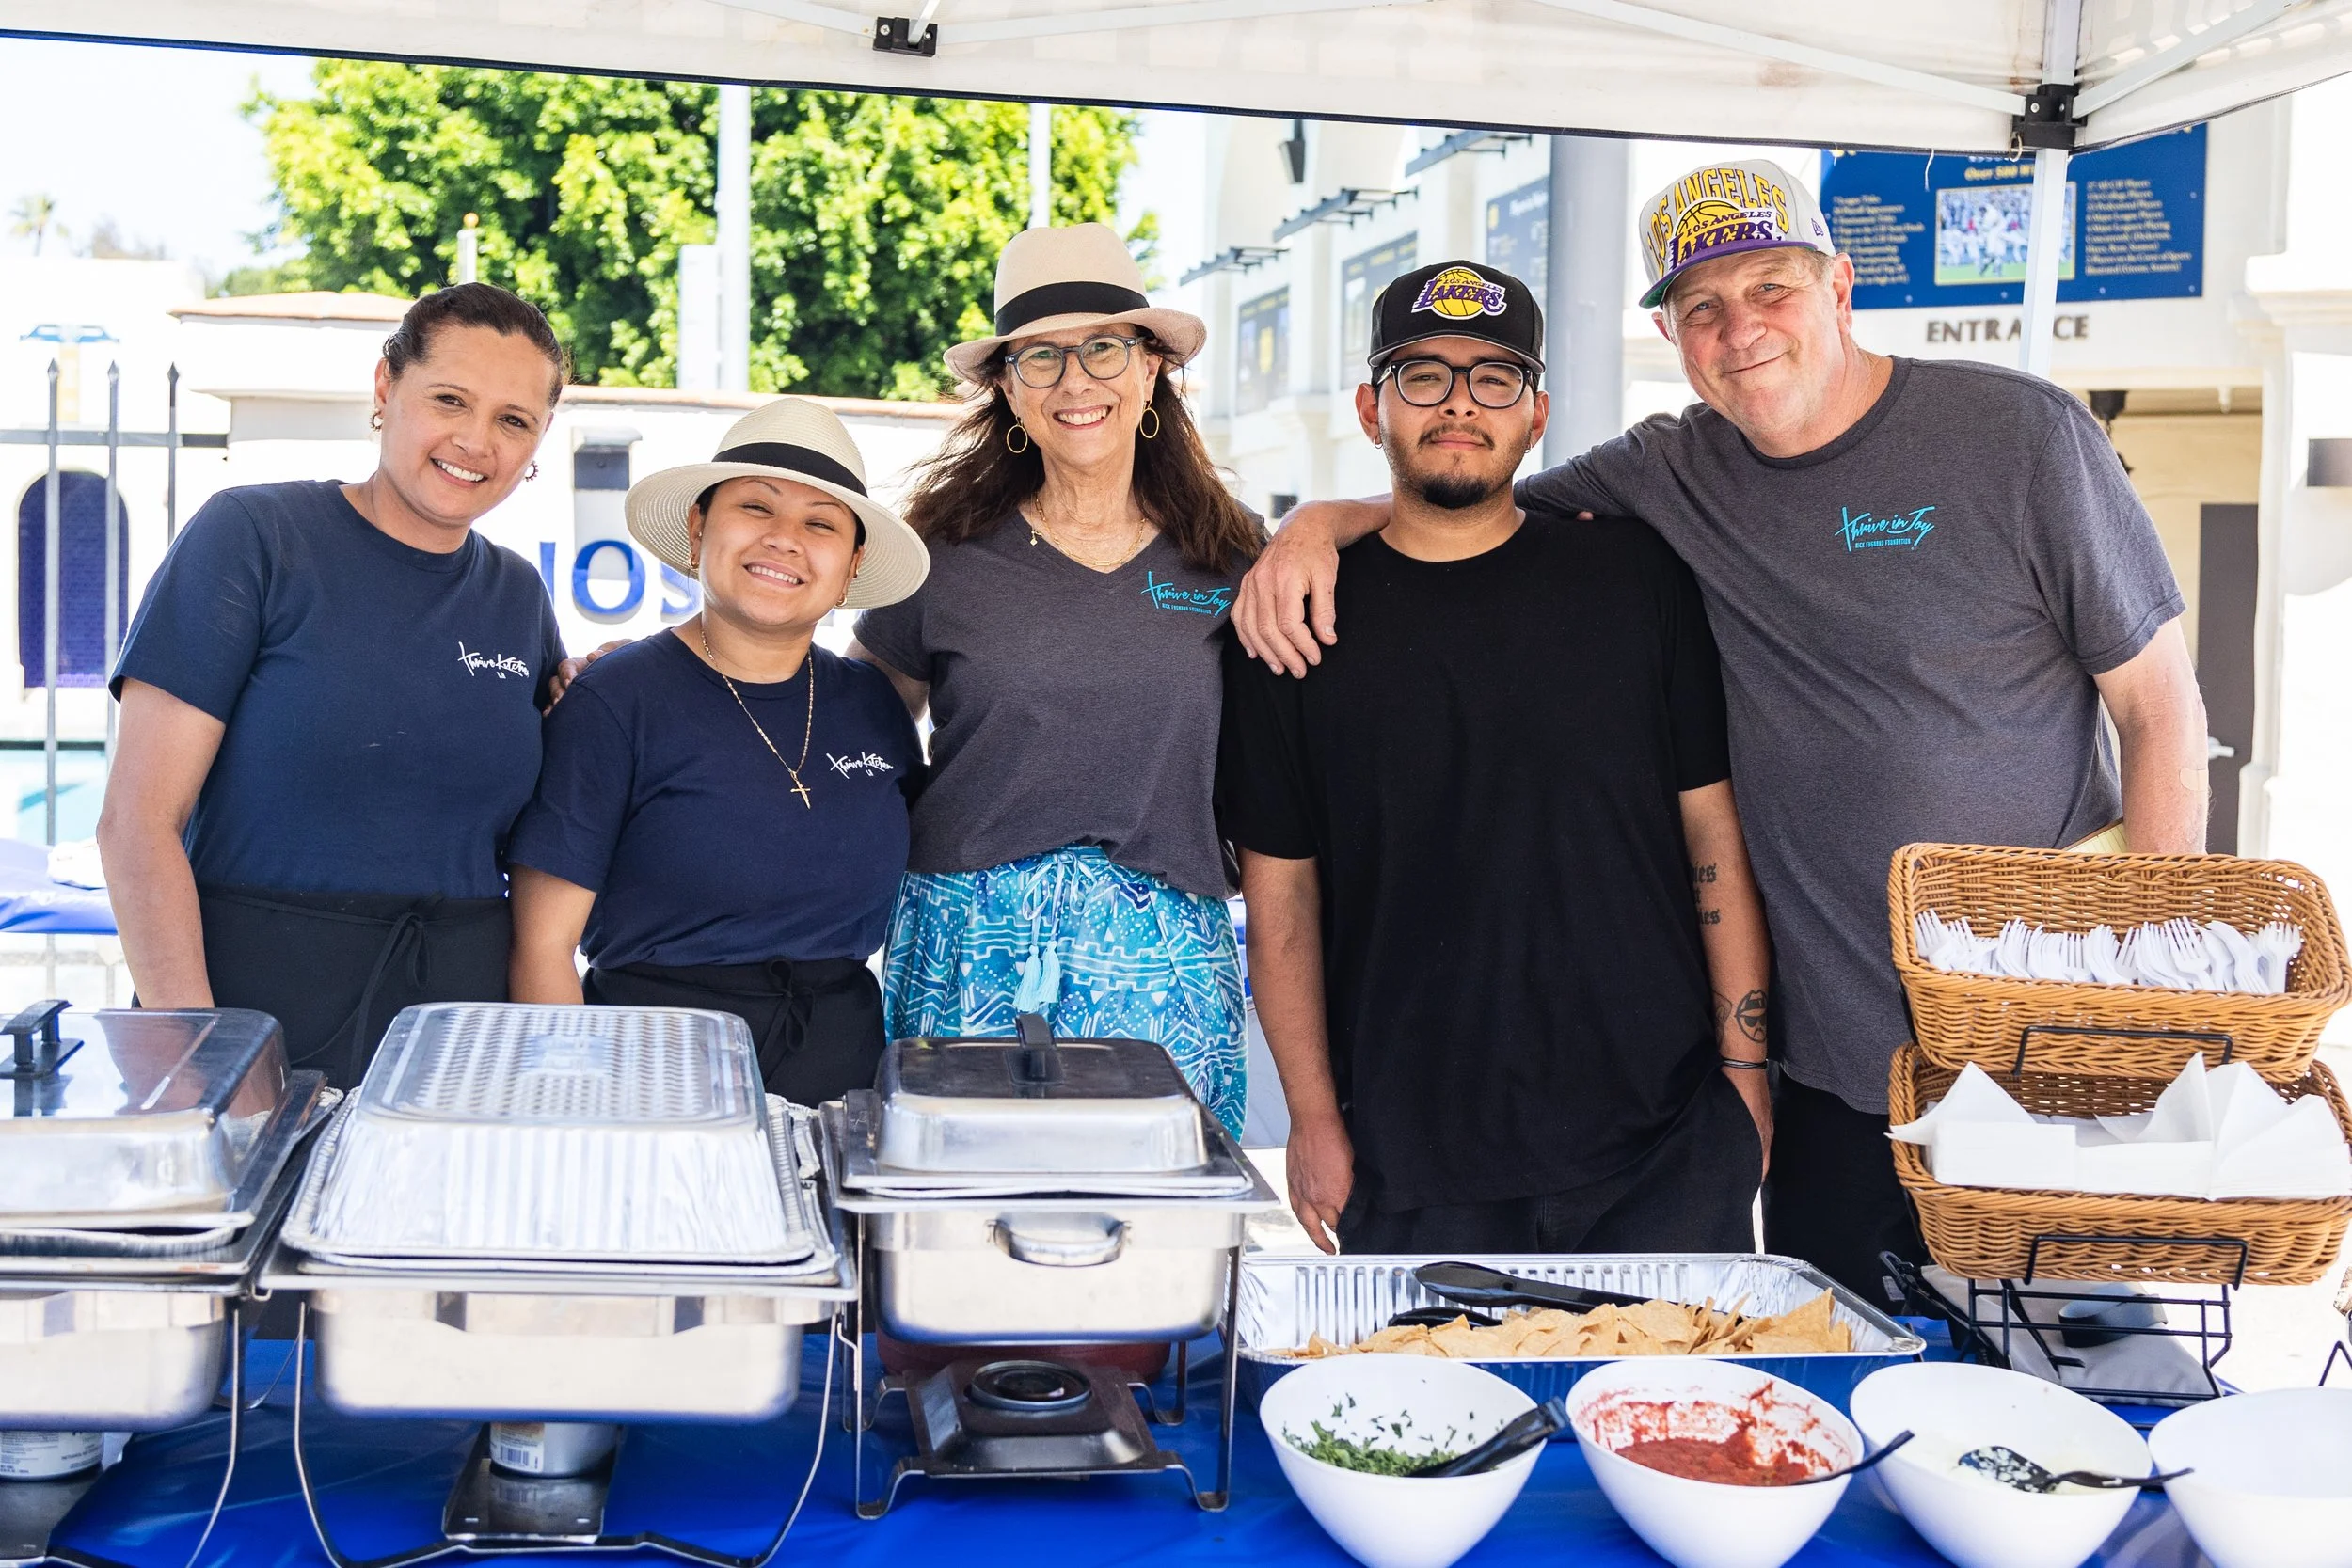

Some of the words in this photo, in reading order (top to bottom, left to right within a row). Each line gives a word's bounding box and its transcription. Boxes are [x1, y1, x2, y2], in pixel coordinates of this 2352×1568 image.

[1674, 167, 1790, 234] ANGELES
[1687, 222, 1708, 238] LOS
[1709, 210, 1772, 226] ANGELES
[1668, 220, 1782, 271] LAKERS
[1414, 279, 1505, 313] LAKERS
[1462, 278, 1502, 293] ANGELES
[1926, 315, 2090, 343] ENTRACE
[1886, 506, 1935, 550] Joy
[1891, 514, 1909, 530] in
[1189, 587, 1232, 618] Joy
[1193, 589, 1208, 601] in
[1693, 860, 1717, 883] ies
[1699, 908, 1721, 926] ies
